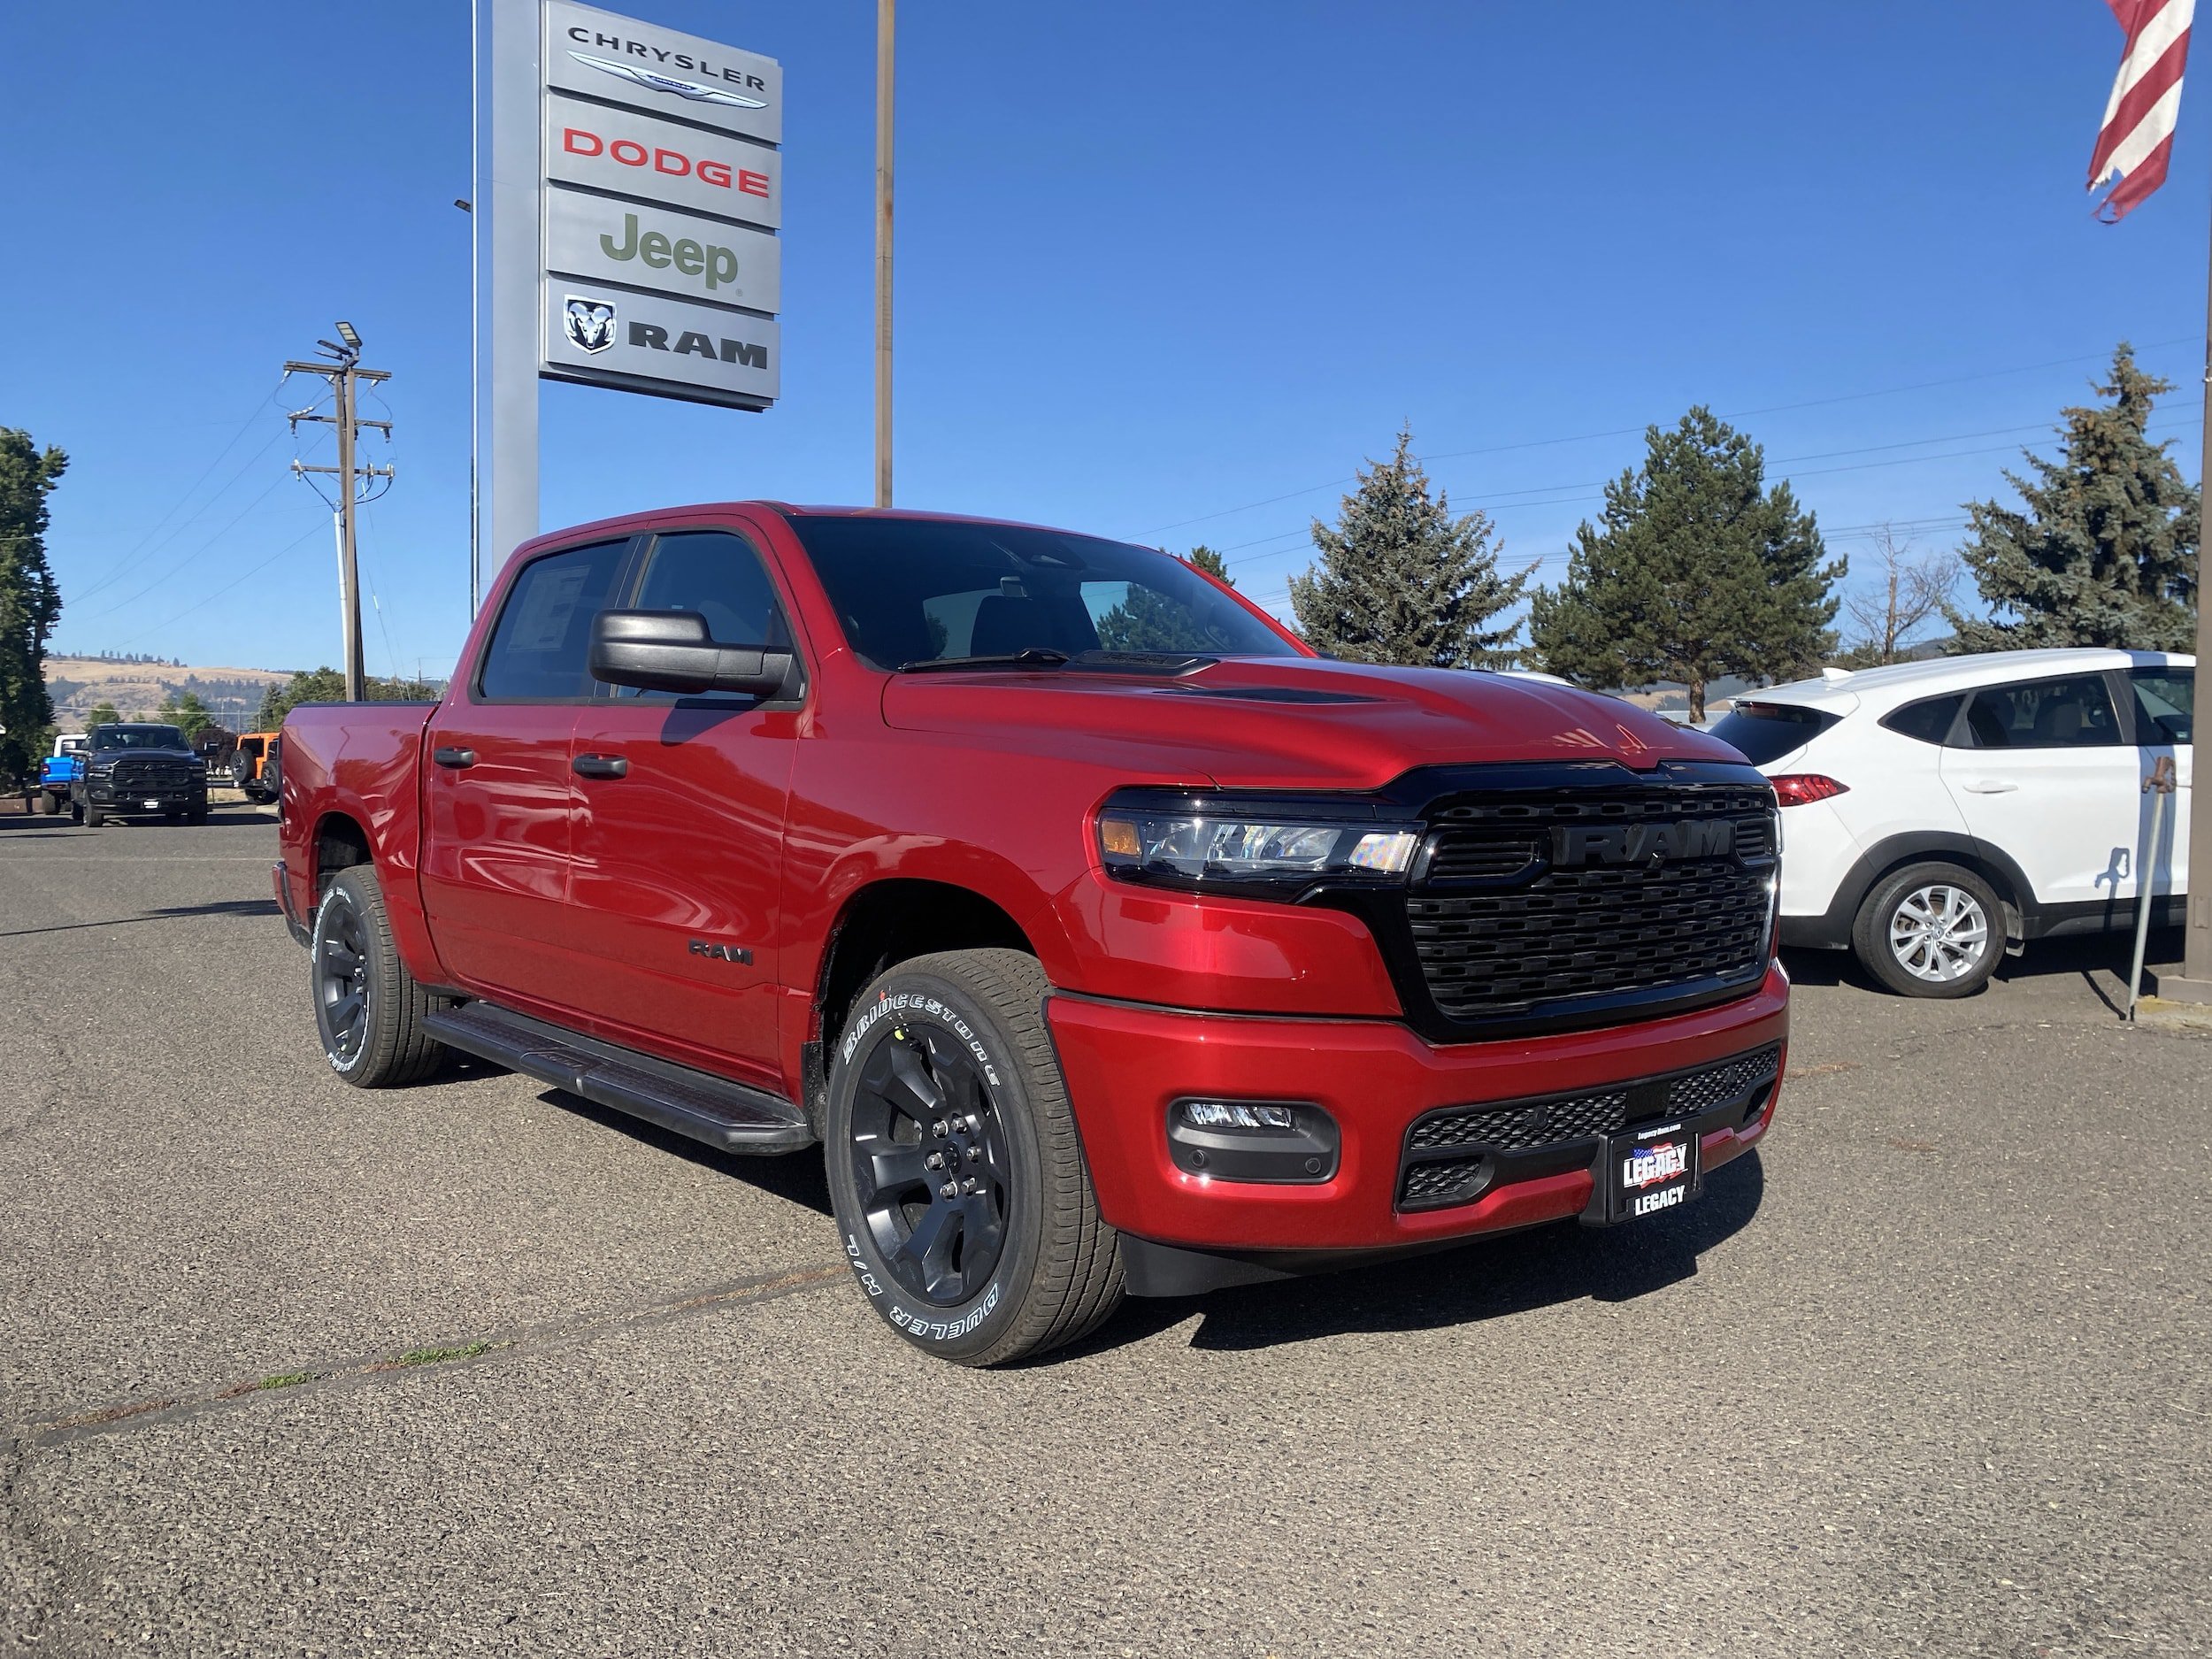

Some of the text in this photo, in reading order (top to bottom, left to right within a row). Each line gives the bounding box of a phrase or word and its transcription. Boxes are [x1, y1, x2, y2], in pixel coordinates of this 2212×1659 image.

[568, 27, 765, 92] CHRYSLER
[564, 127, 769, 198] DODGE
[600, 213, 738, 290] Jeep
[628, 321, 767, 370] RAM
[1549, 819, 1733, 866] RAM
[688, 939, 754, 966] RAM
[841, 993, 1000, 1087] BRIDGESTONE
[1624, 1145, 1686, 1187] LEGACY
[1635, 1185, 1686, 1217] LEGACY
[889, 1282, 999, 1341] DUELER
